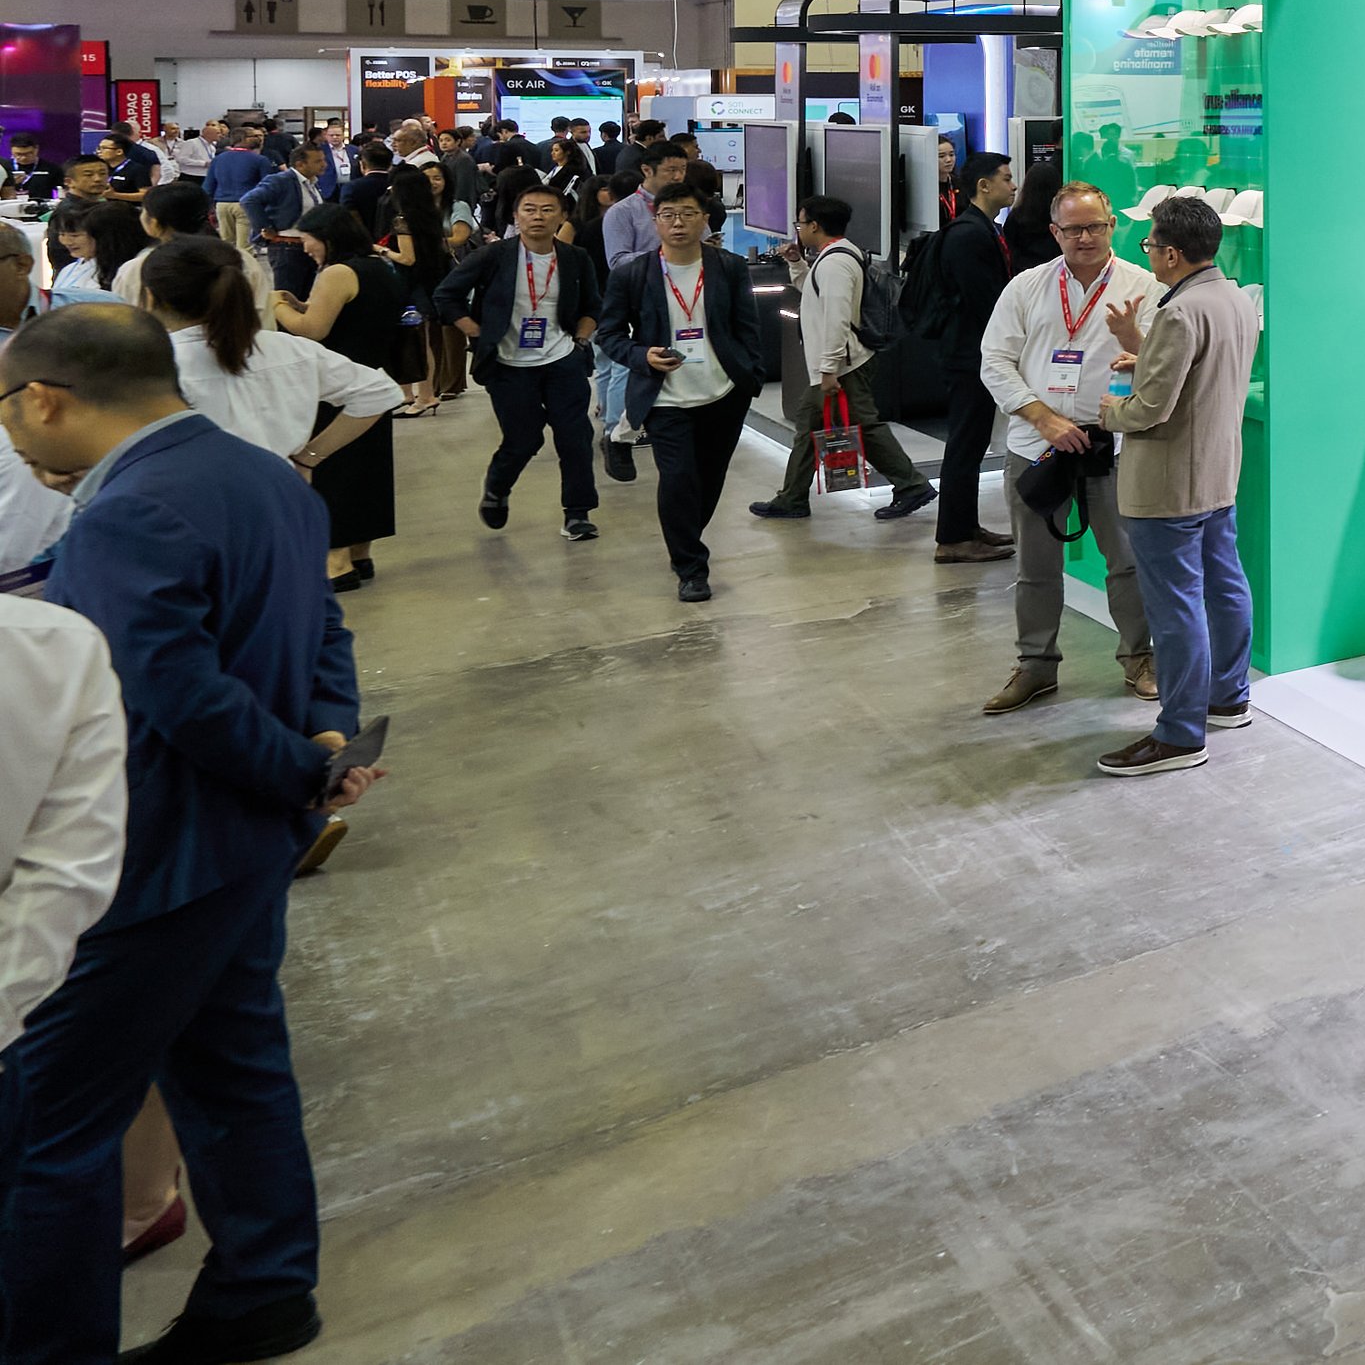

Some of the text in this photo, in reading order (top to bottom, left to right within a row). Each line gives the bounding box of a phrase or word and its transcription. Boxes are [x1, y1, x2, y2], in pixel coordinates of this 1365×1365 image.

[365, 71, 416, 79] Better POS
[506, 80, 545, 89] GK AIR
[142, 93, 151, 133] Lounge
[900, 105, 915, 113] GK
